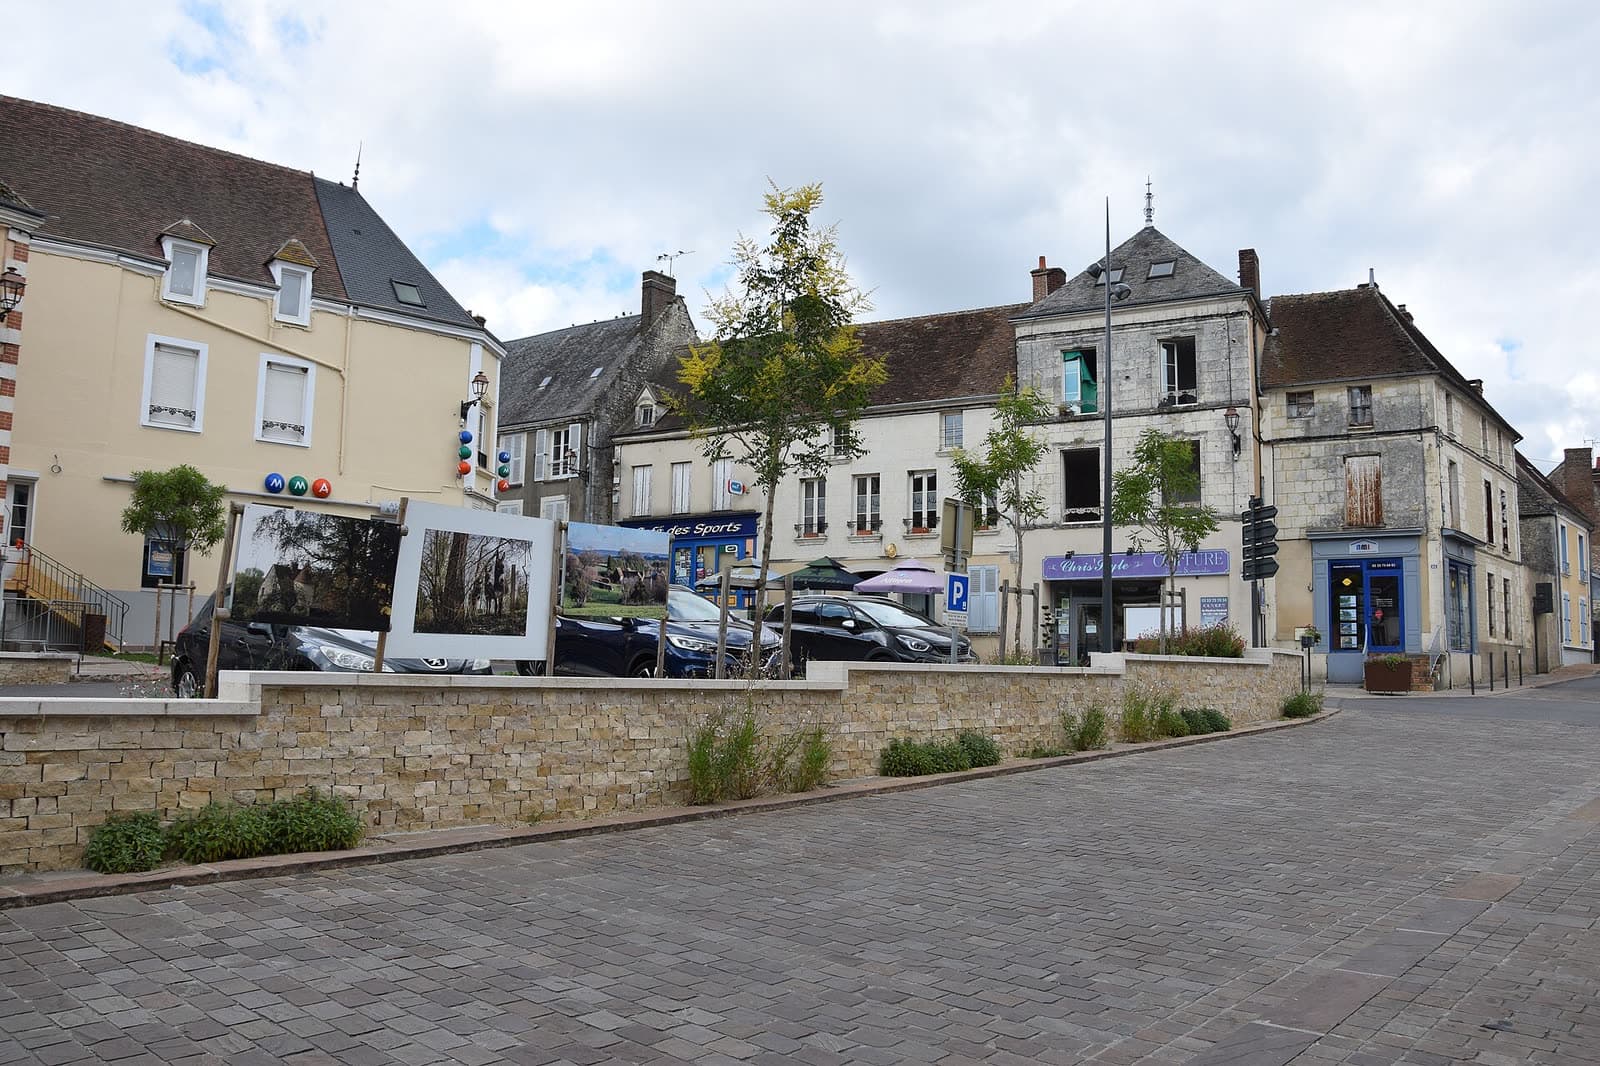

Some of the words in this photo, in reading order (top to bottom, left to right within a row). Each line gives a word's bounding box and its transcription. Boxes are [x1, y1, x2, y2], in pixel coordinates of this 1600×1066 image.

[269, 477, 330, 494] MMA
[667, 525, 690, 535] des
[693, 523, 742, 536] Sports
[953, 581, 964, 605] P
